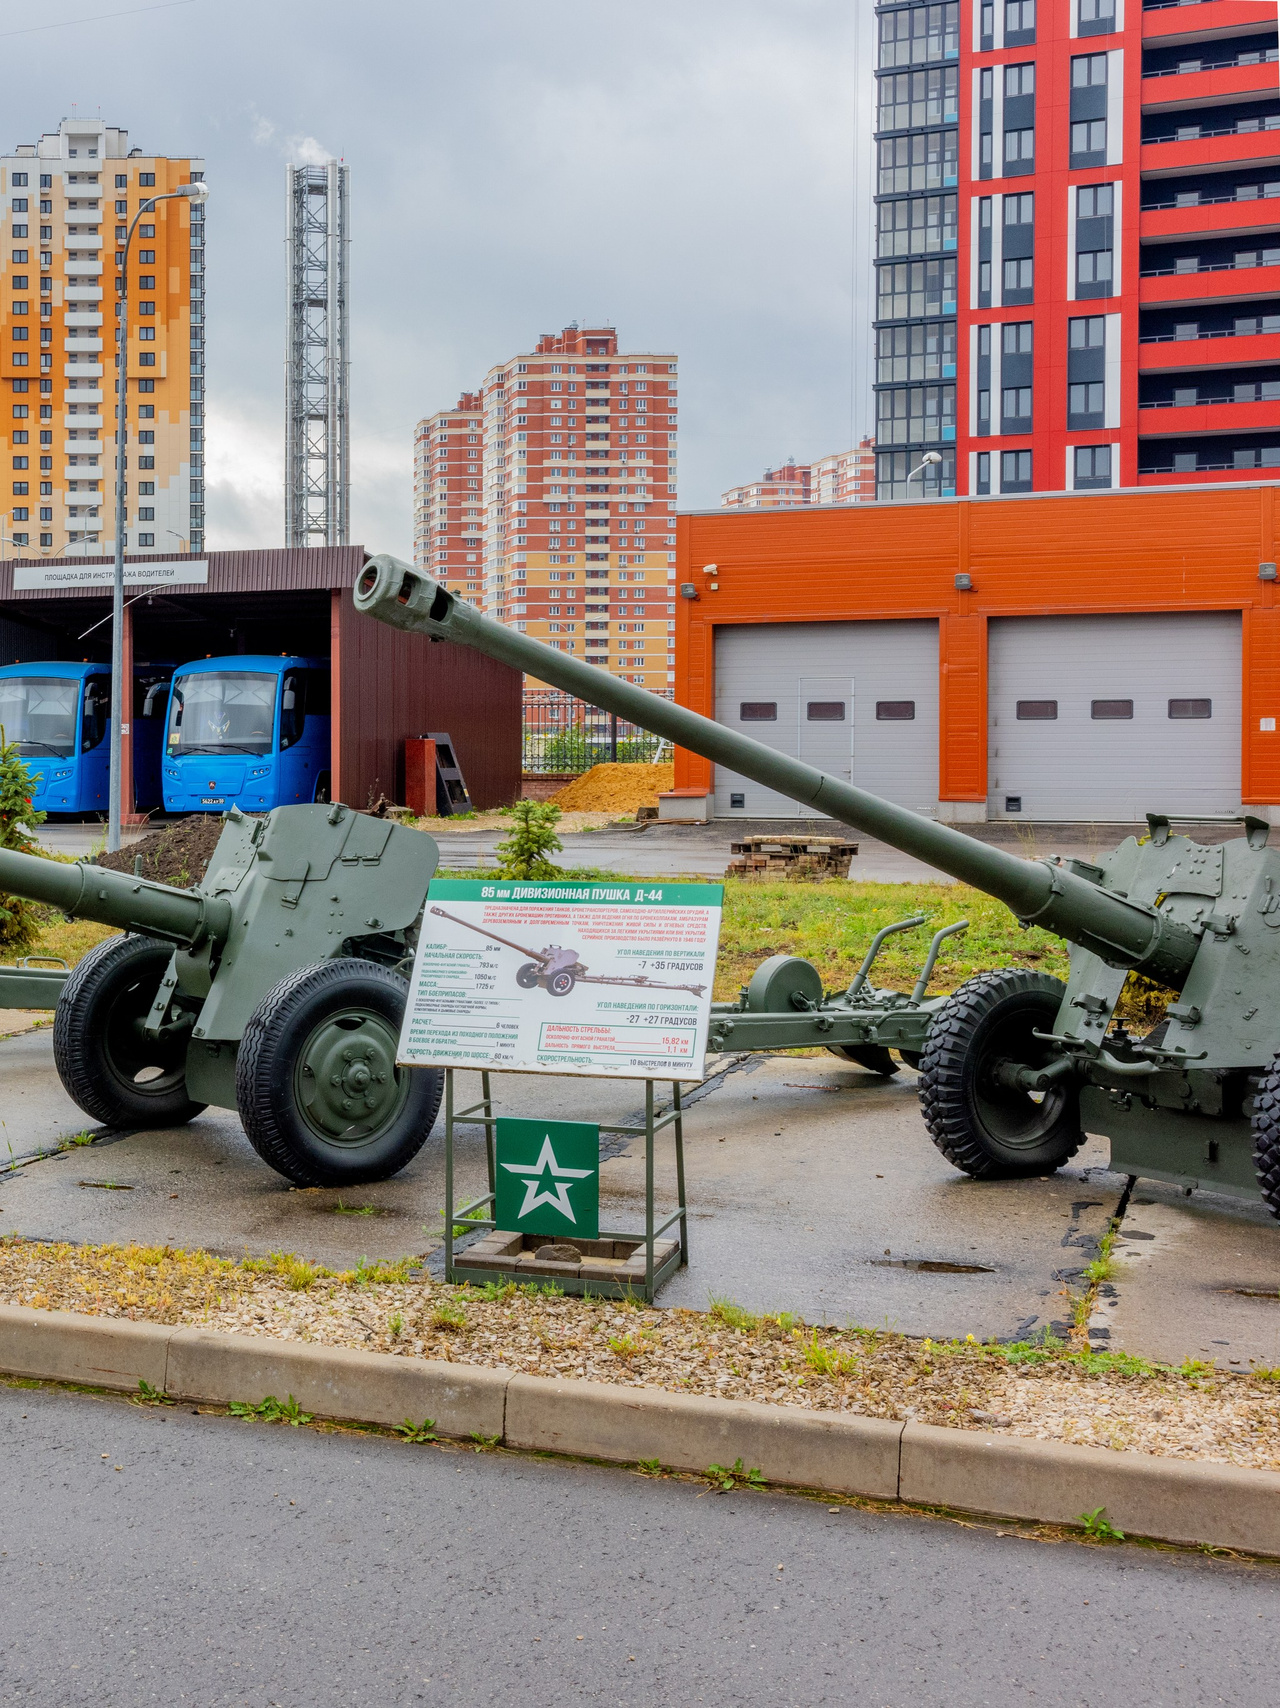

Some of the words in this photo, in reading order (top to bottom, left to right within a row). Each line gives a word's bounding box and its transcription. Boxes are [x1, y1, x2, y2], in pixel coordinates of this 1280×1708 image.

[138, 569, 174, 577] ВОДИТЕЛЕЙ
[481, 887, 495, 898] 85
[511, 887, 590, 900] ДИВИЗИОННАЯ
[591, 888, 630, 900] ПУШКА
[635, 890, 663, 902] Д-44
[638, 961, 647, 969] -7
[650, 961, 665, 970] +35
[666, 962, 703, 971] ГРАДУСОВ
[626, 1015, 640, 1024] -27
[643, 1015, 659, 1024] +27
[660, 1016, 697, 1026] ГРАДУСОВ
[546, 1025, 580, 1033] ДАЛЬНОСТЬ
[580, 1026, 612, 1034] СТРЕЛЬБЫ:
[536, 1054, 594, 1064] СКОРОСТРЕЛЬНОСТЬ:
